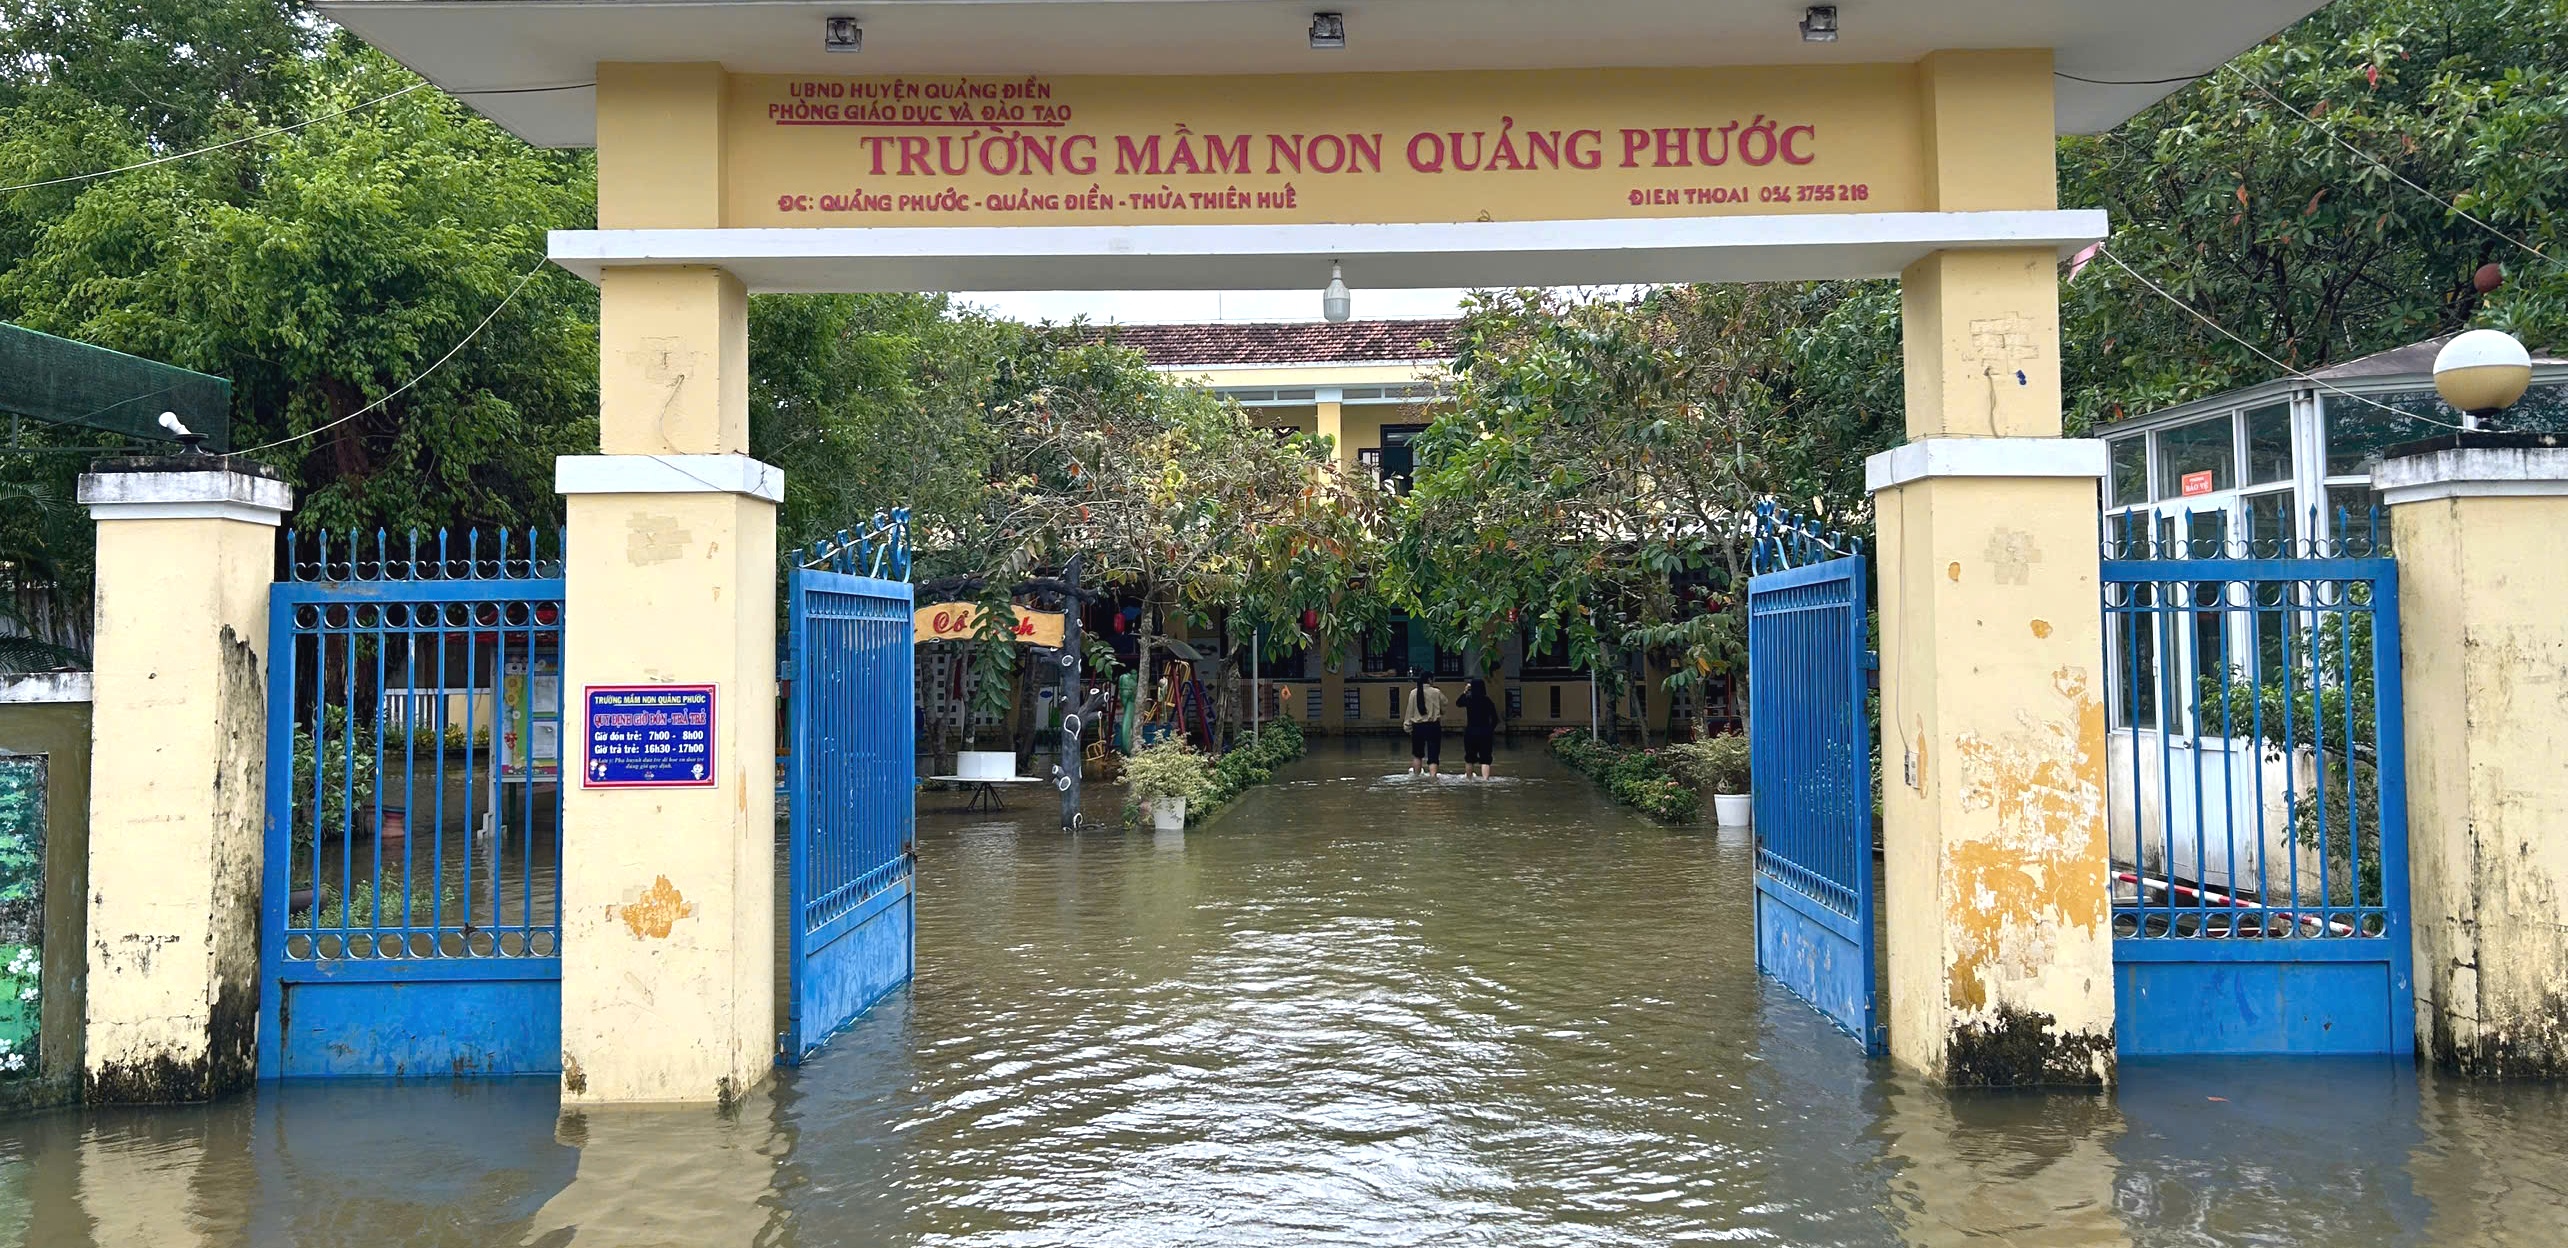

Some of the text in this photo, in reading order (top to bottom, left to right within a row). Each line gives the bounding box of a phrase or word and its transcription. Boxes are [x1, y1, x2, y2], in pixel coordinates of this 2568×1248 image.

[790, 82, 845, 98] UBND
[851, 79, 920, 102] HUYỆN
[924, 77, 997, 99] QUẢNG
[768, 98, 839, 120] PHÒNG
[844, 100, 897, 120] GIÁO
[949, 102, 975, 120] VÀ
[981, 100, 1025, 120] ĐÀO
[861, 113, 1816, 176] TRƯỜNG MẦM NON QUẢNG PHƯỚC
[820, 188, 893, 212] QUẢNG
[898, 187, 969, 212] PHƯỚC
[987, 187, 1060, 211] QUẢNG
[1065, 183, 1114, 210] ĐIỀN
[1129, 184, 1187, 209] THỪA
[1189, 185, 1251, 209] THIÊN
[1257, 182, 1297, 209] HUẾ
[1797, 185, 1836, 202] 3755
[1838, 184, 1869, 202] 218
[594, 731, 608, 741] Giờ
[609, 732, 625, 741] đón
[648, 730, 670, 740] 7h00
[682, 730, 704, 740] 8h00
[594, 744, 608, 754] Giờ
[644, 743, 671, 753] 16h30
[678, 743, 704, 753] 17h00
